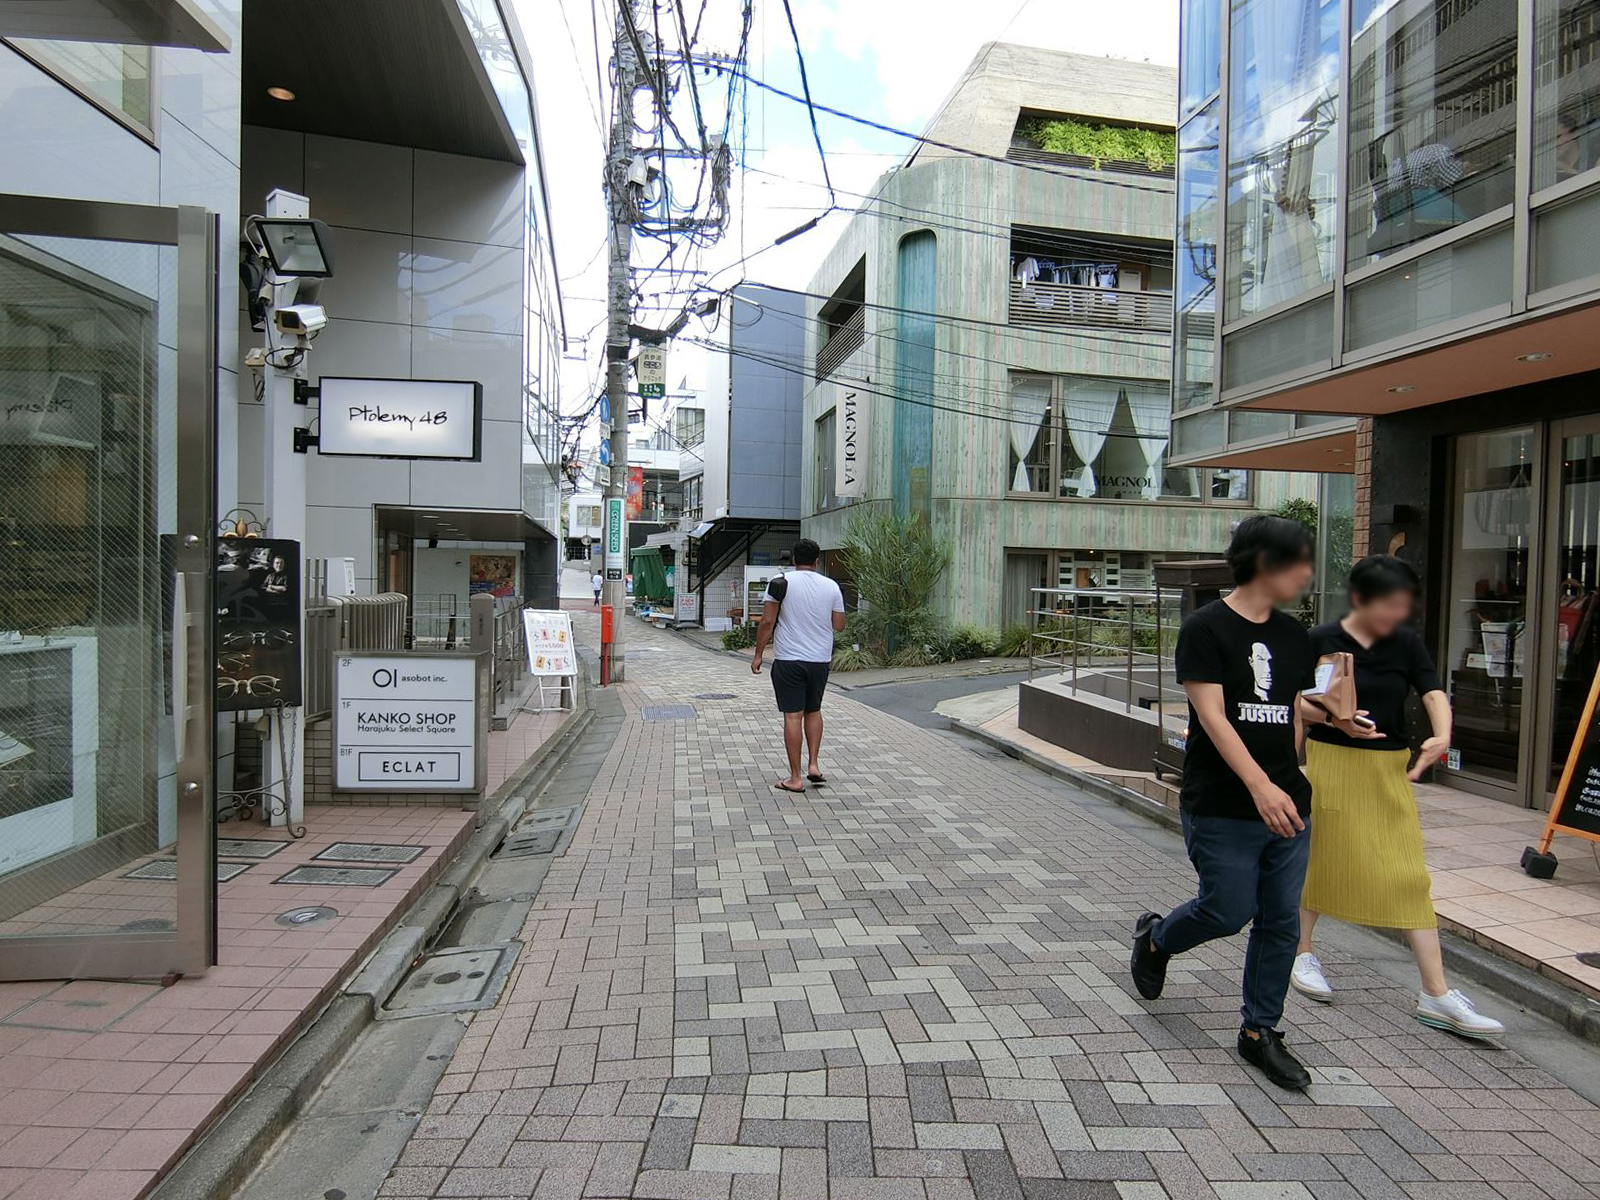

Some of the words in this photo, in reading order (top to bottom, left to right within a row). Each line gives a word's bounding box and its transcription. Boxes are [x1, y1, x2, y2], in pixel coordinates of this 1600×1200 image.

[349, 405, 416, 431] Ptolemy
[419, 411, 448, 425] 48
[342, 659, 353, 667] 2F
[401, 674, 431, 682] asobot
[433, 674, 447, 682] inc.
[342, 701, 352, 709] 1F
[358, 712, 411, 724] KANKO
[416, 713, 456, 725] SHOP
[1238, 708, 1289, 724] JUSTICE
[357, 725, 396, 734] Harajuku
[399, 725, 424, 733] Select
[426, 725, 456, 734] Square
[340, 748, 353, 756] B1F
[382, 761, 436, 773] ECLAT
